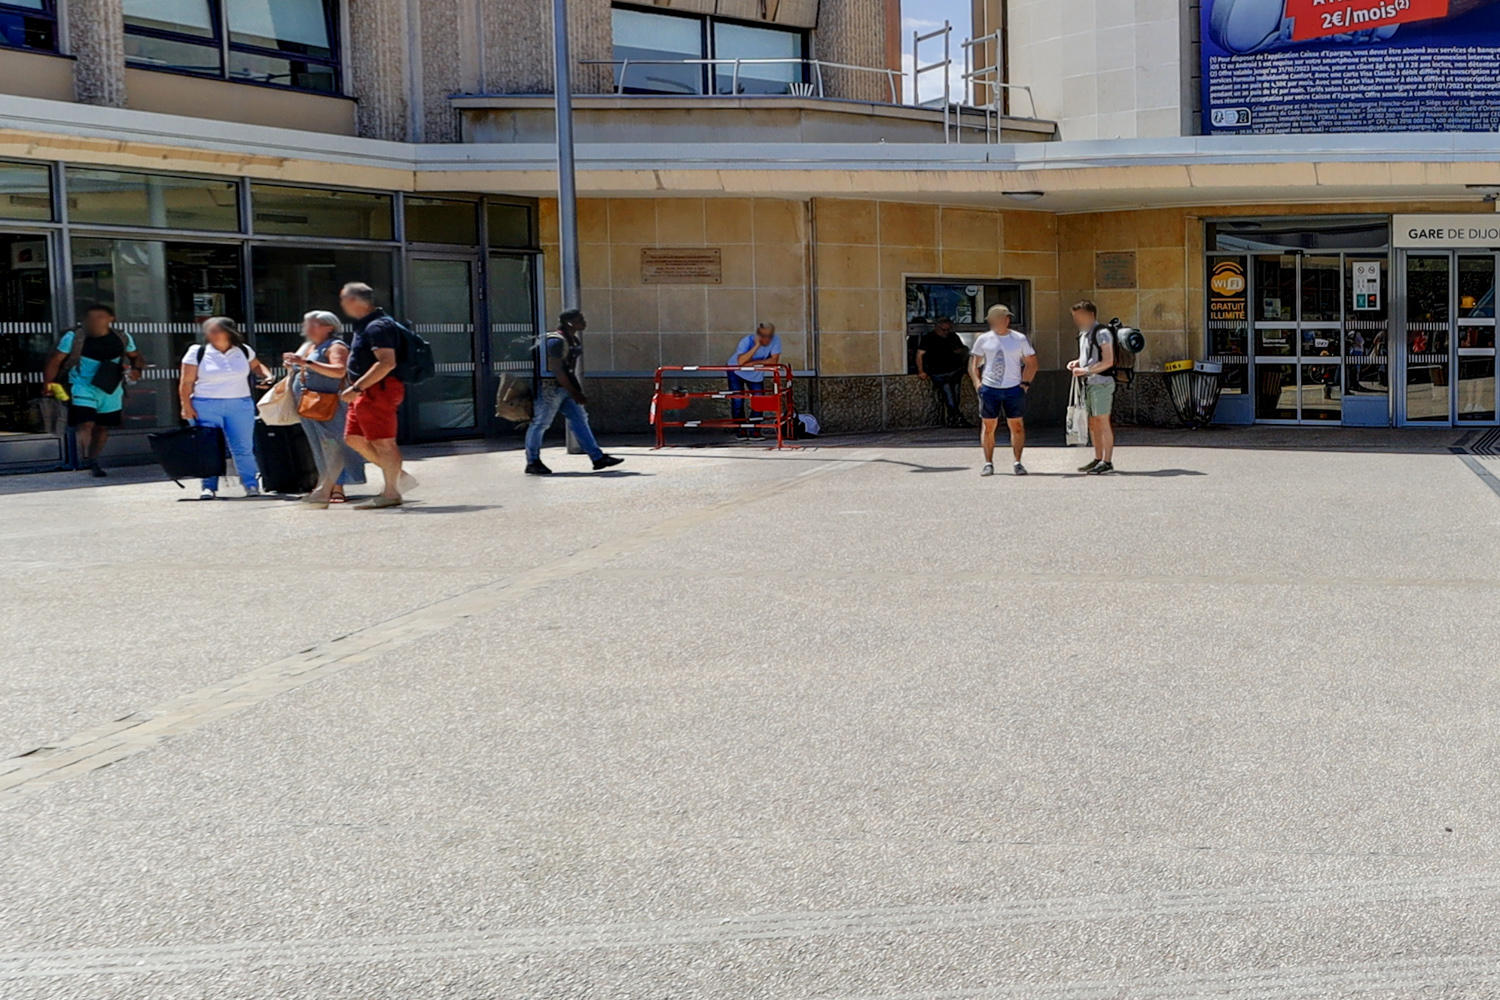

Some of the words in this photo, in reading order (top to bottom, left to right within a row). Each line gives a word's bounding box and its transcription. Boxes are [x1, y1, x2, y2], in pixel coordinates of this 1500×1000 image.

[1408, 228, 1444, 240] GARE
[1448, 228, 1465, 239] DE
[1210, 302, 1246, 310] GRATUIT
